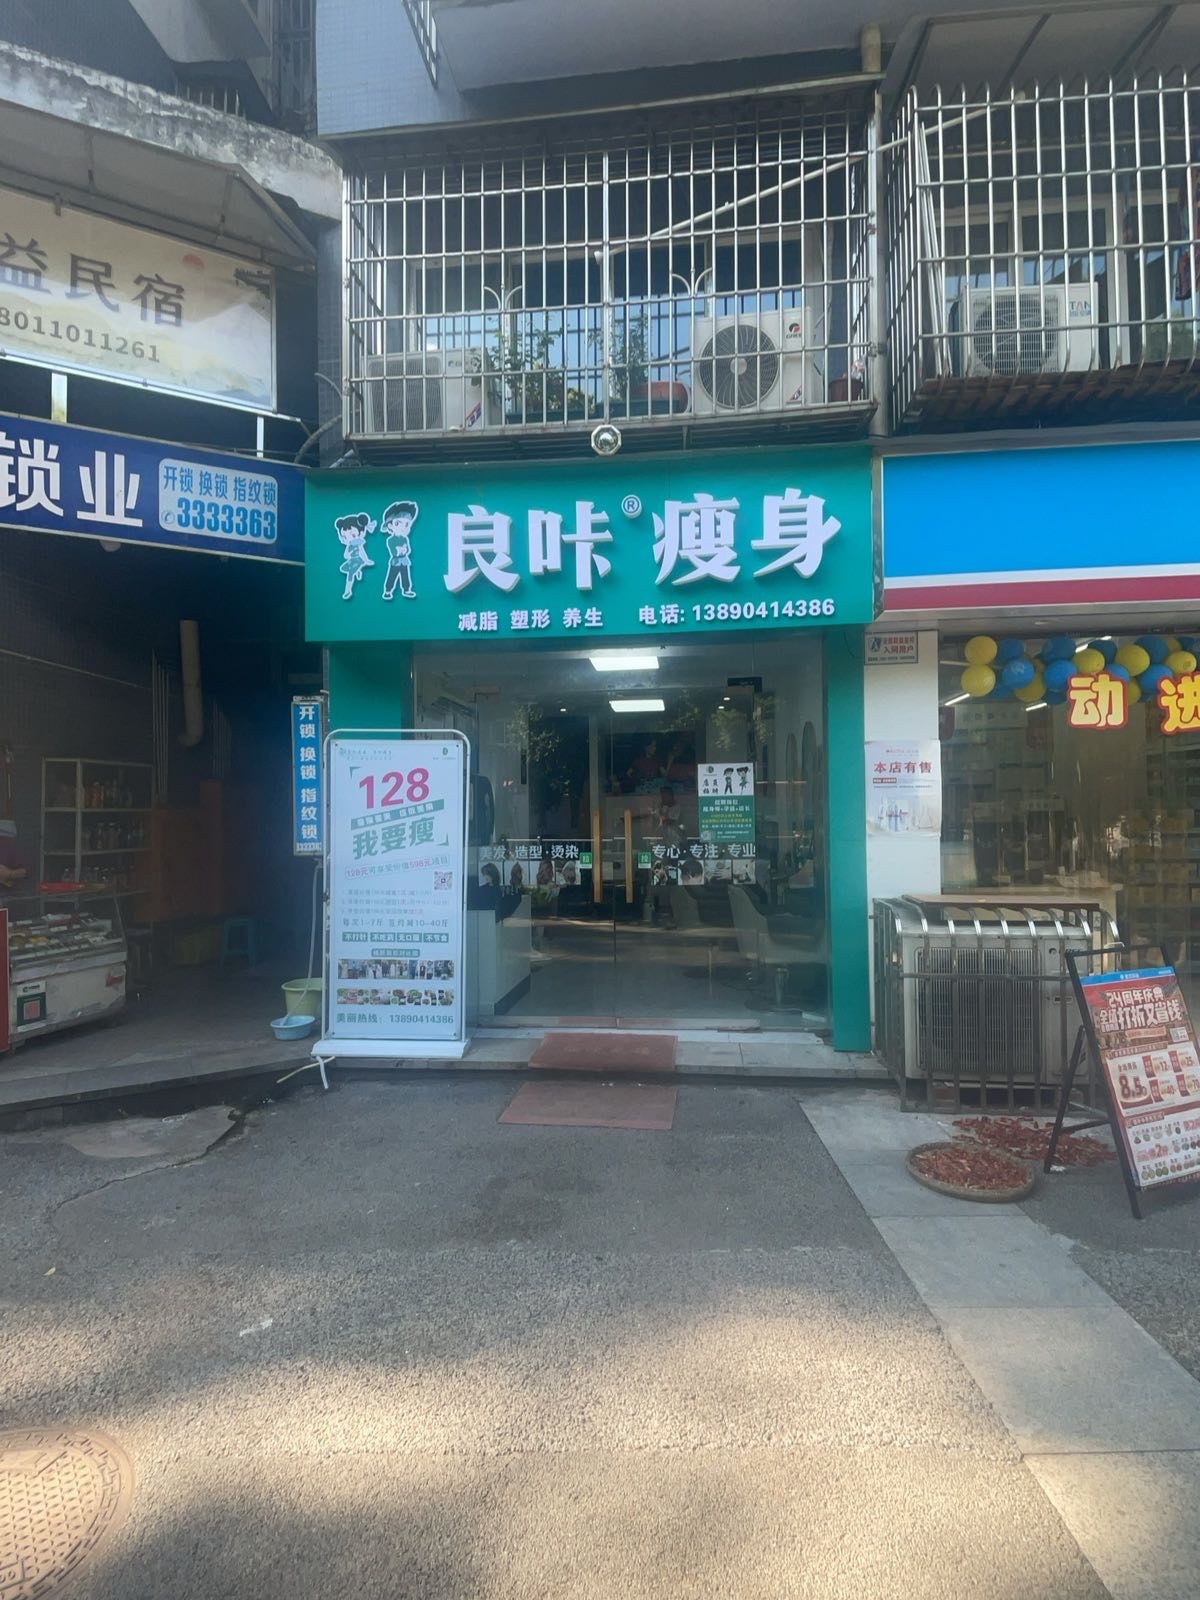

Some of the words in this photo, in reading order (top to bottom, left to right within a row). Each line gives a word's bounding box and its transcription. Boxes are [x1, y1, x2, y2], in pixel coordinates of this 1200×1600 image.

[0, 431, 143, 527] 锁业
[163, 465, 194, 495] 开锁
[199, 470, 228, 499] 换锁
[233, 476, 277, 507] 指纹锁
[177, 497, 277, 540] 3333363
[442, 500, 614, 595] 良咔
[651, 487, 842, 586] 瘦身
[457, 608, 499, 632] 减脂
[510, 608, 551, 630] 塑形
[562, 606, 604, 629] 养生
[691, 598, 835, 625] 13890414386
[299, 706, 316, 738] 开锁
[359, 767, 430, 810] 128
[874, 761, 932, 774] 本店有售
[301, 788, 318, 839] 指纹锁
[353, 816, 435, 860] 我要瘦
[1106, 986, 1165, 1008] 24周年庆典
[389, 1014, 454, 1024] 13890414386
